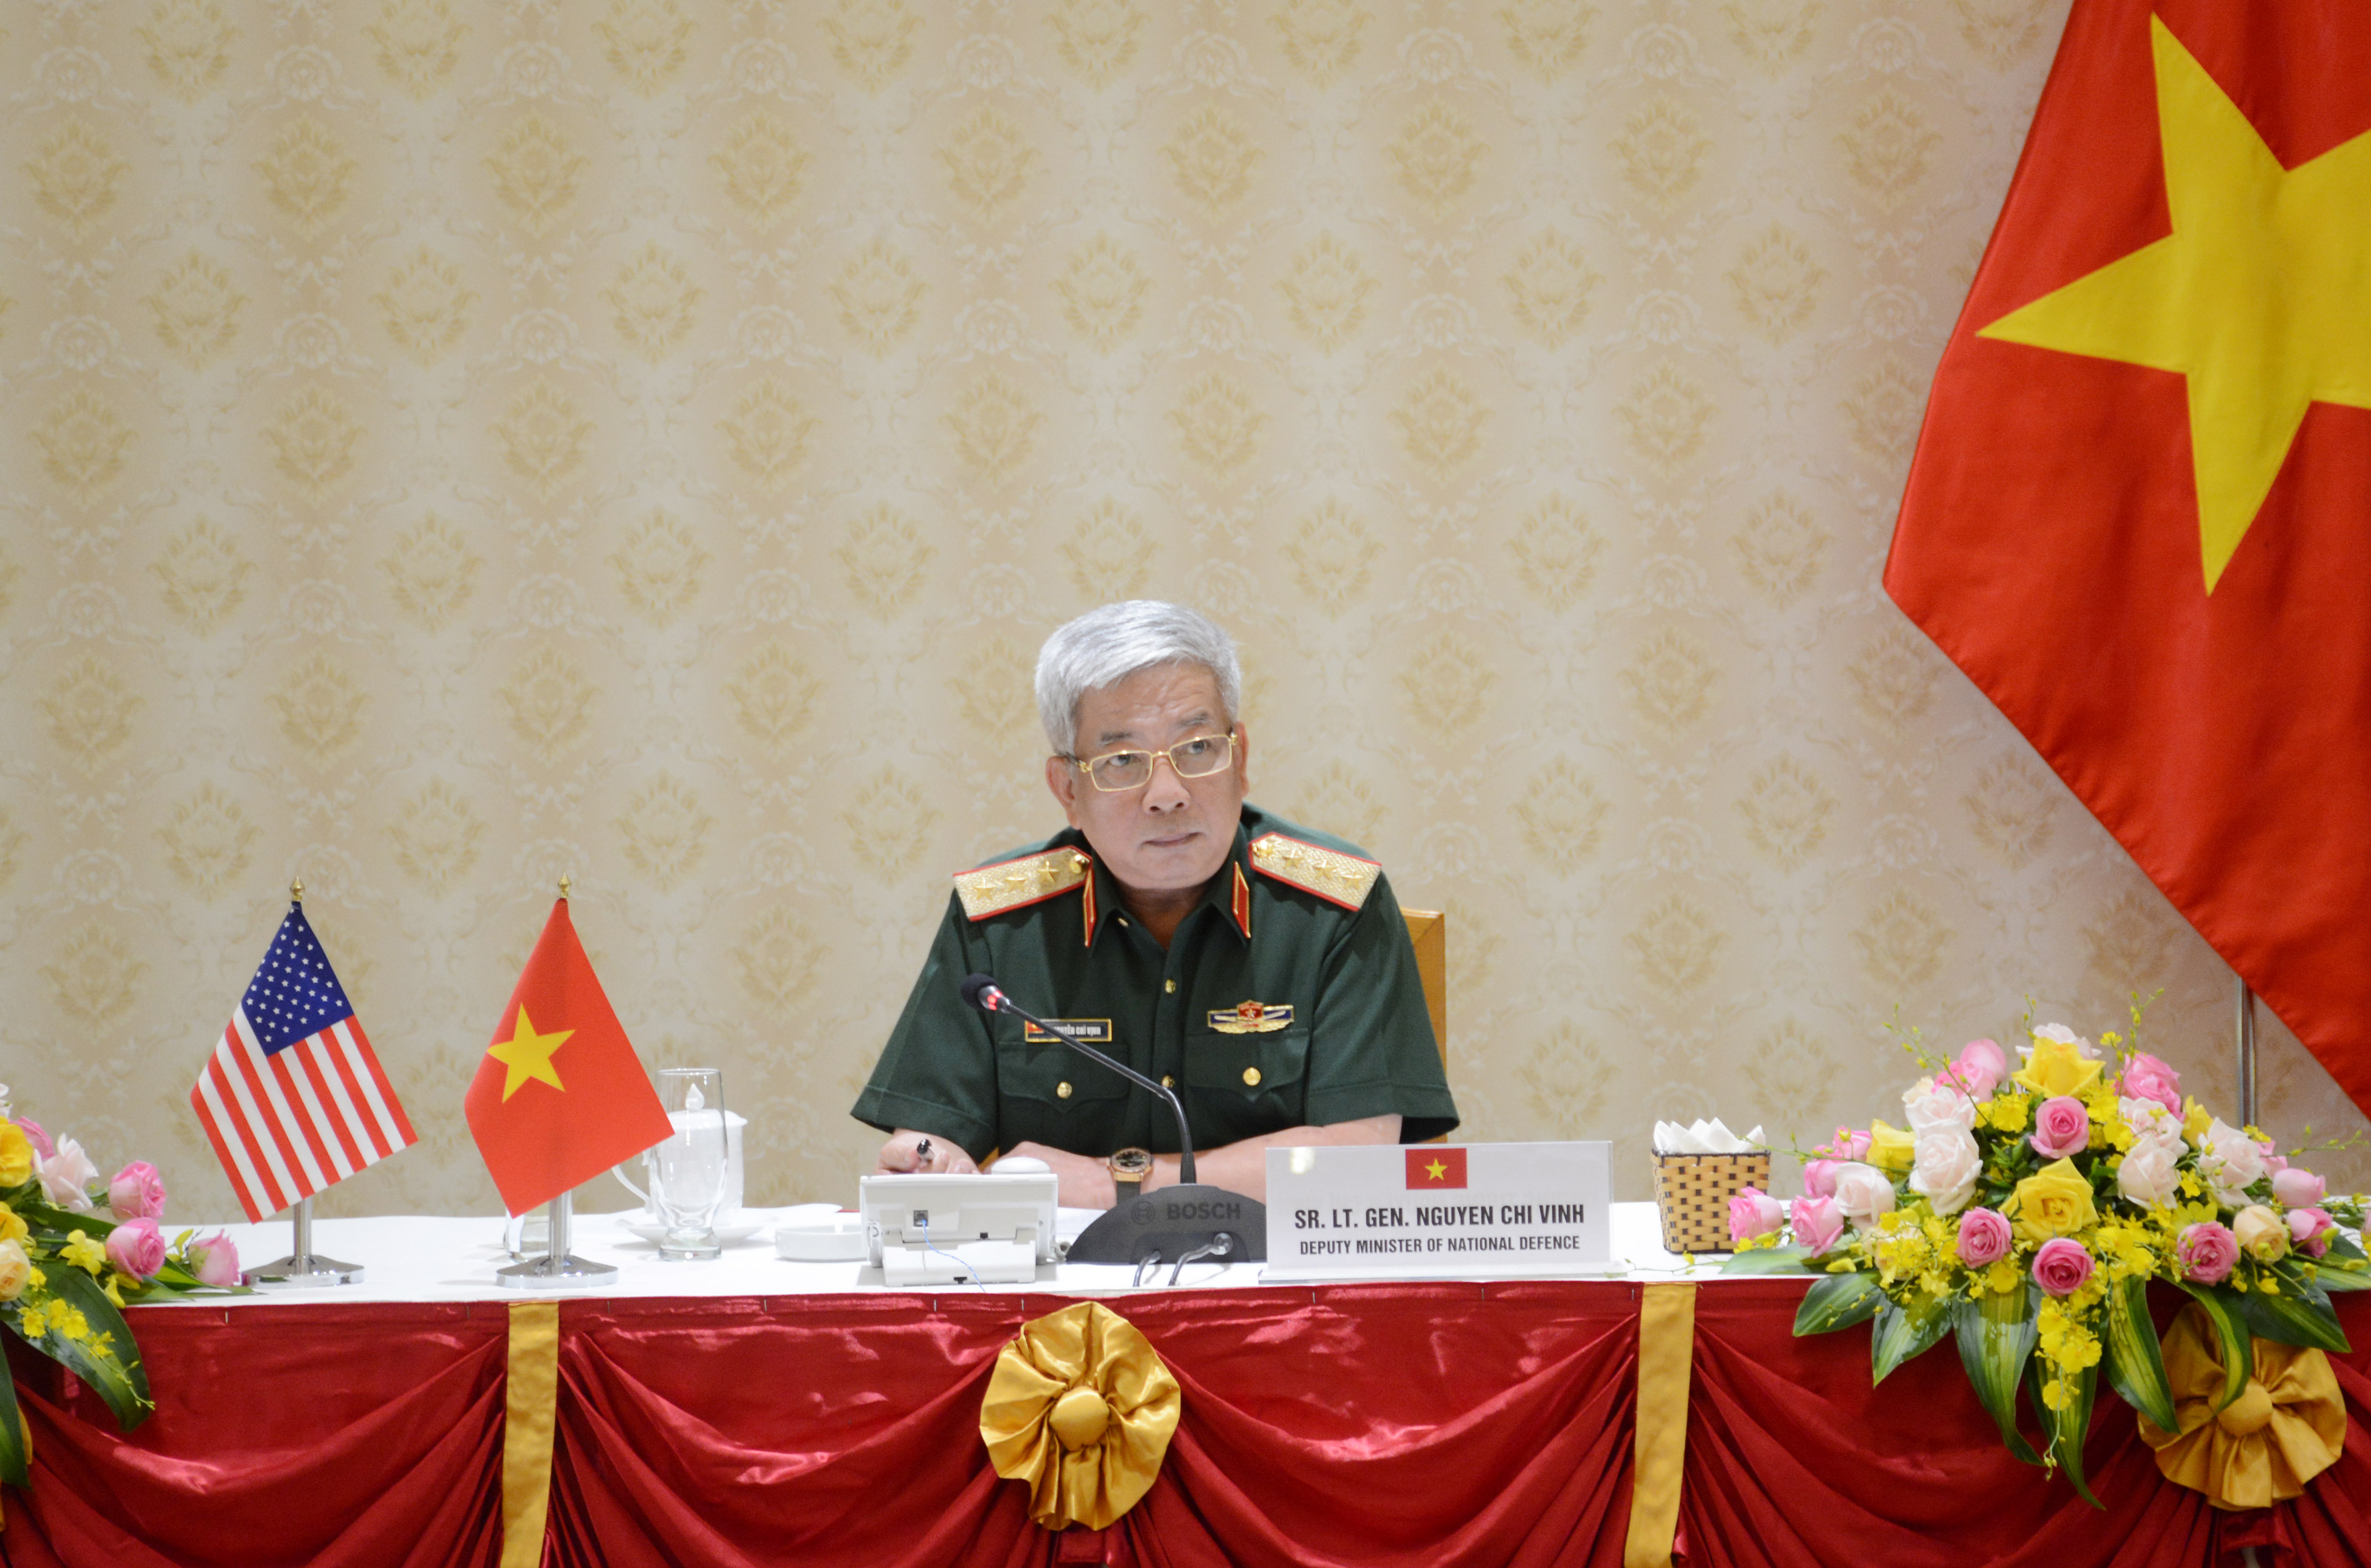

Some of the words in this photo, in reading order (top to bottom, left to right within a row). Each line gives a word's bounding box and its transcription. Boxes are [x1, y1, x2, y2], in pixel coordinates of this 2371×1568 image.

[1166, 1202, 1241, 1220] BOSCH
[1295, 1209, 1325, 1229] SR.
[1332, 1209, 1358, 1228] LT.
[1365, 1207, 1409, 1227] GEN.
[1416, 1206, 1493, 1226] NGUYEN
[1501, 1205, 1532, 1225] CHI
[1539, 1204, 1584, 1224] VINH
[1300, 1241, 1351, 1255] DEPUTY
[1356, 1238, 1422, 1253] MINISTER
[1427, 1238, 1442, 1251] OF
[1448, 1237, 1514, 1251] NATIONAL
[1520, 1236, 1580, 1250] DEFENCE
